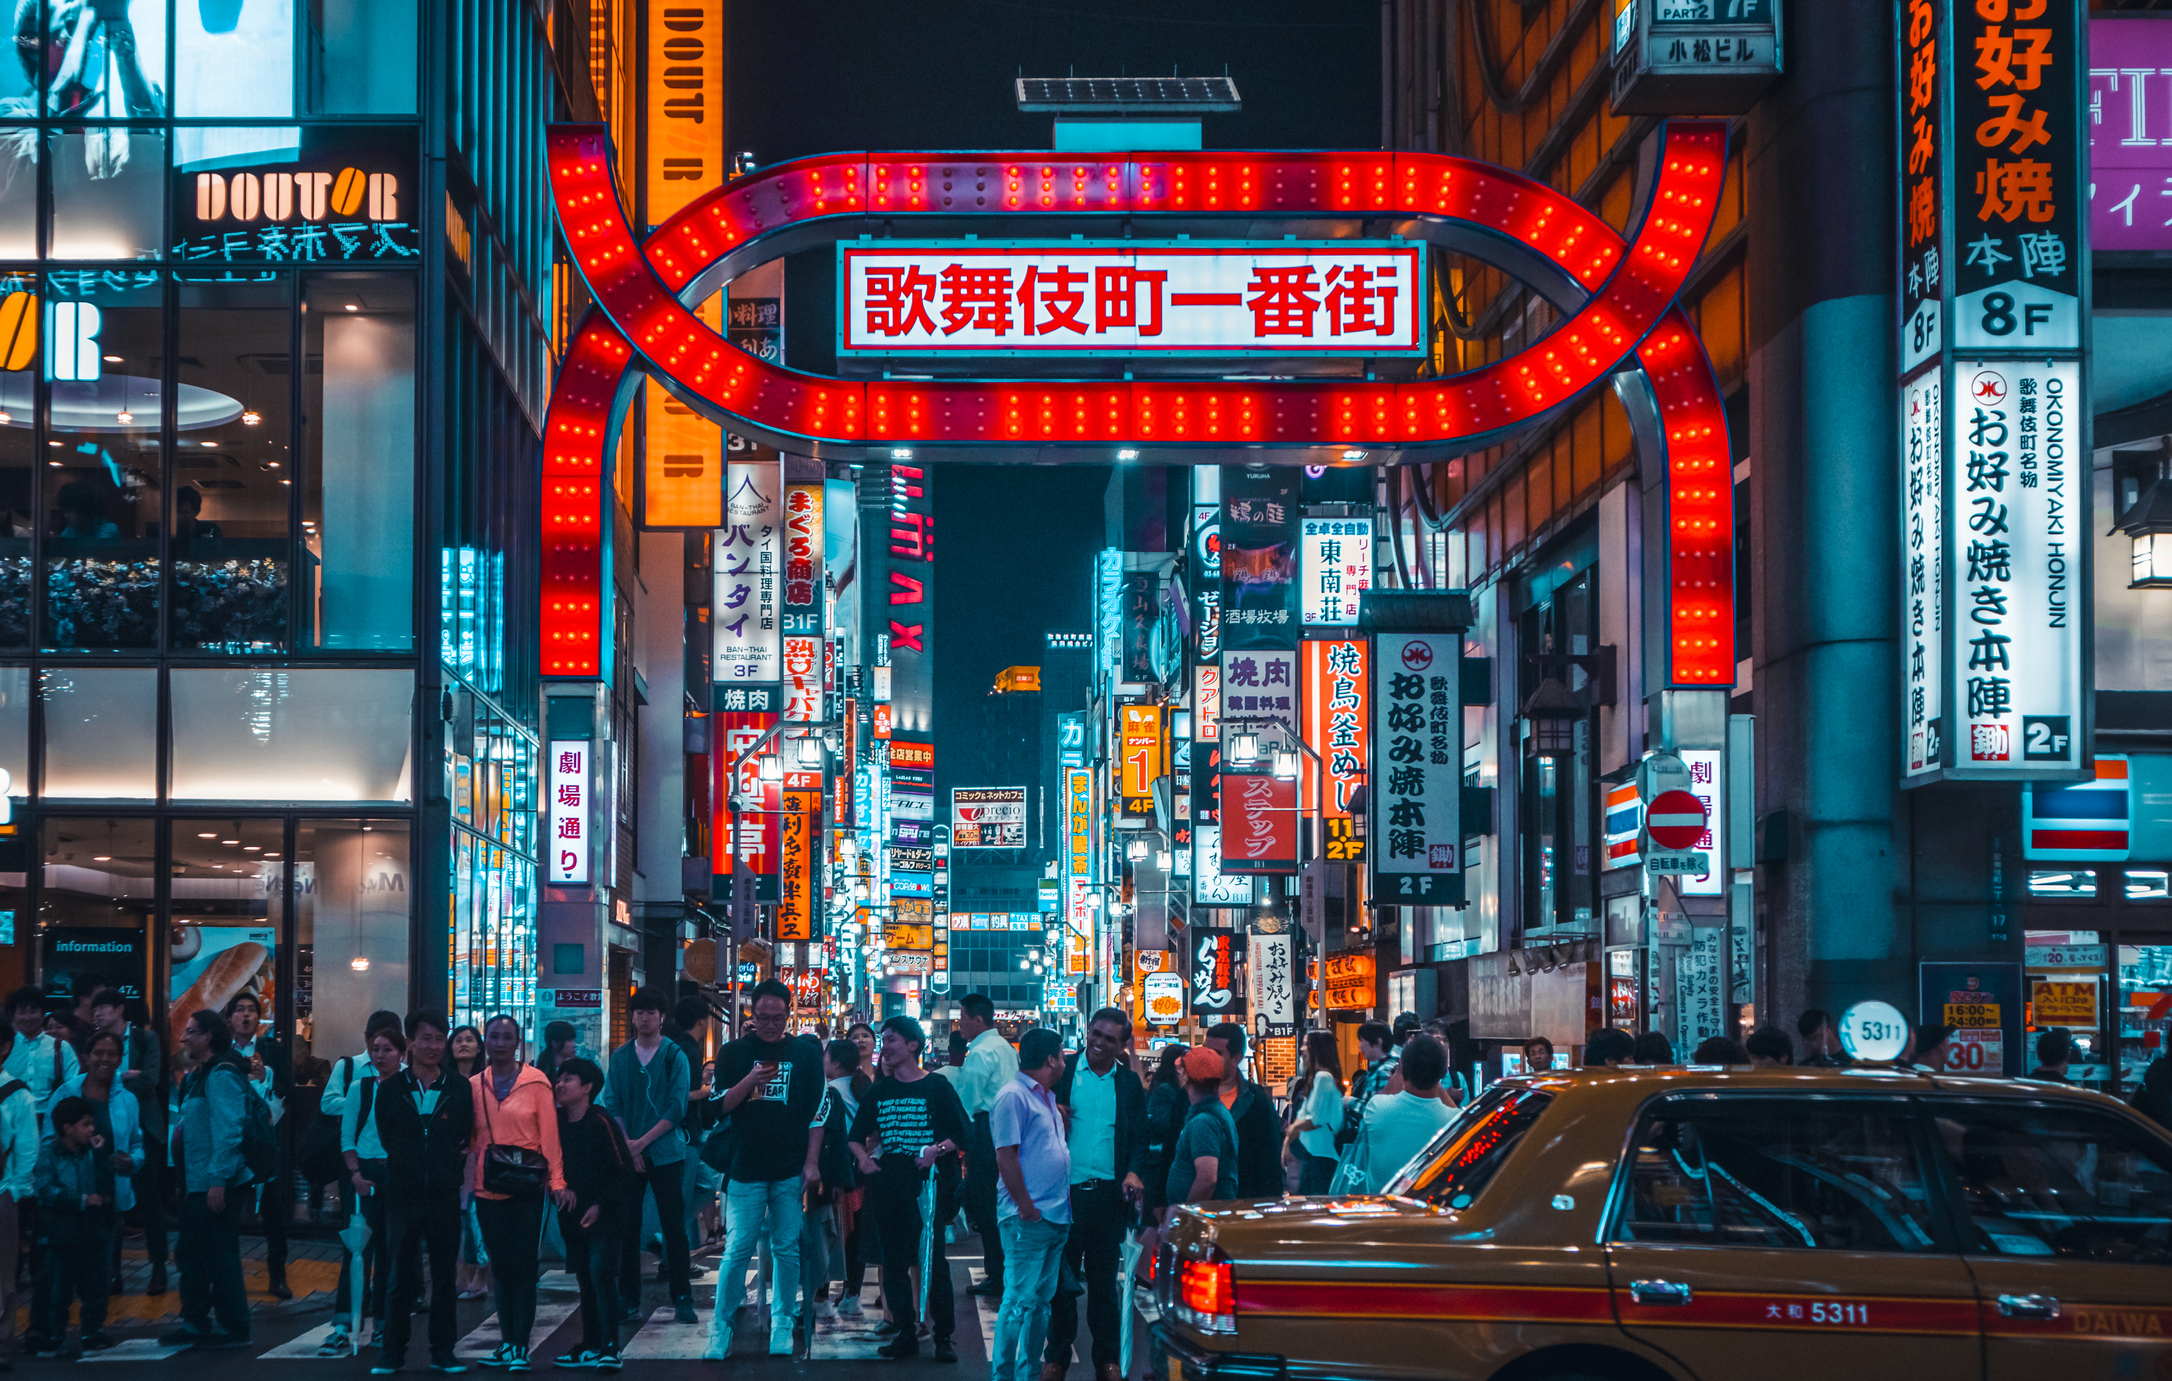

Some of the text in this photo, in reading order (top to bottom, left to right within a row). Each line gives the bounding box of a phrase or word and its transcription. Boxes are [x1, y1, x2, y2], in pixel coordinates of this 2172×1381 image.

[1664, 6, 1708, 19] PART2
[1669, 39, 1754, 62] 小松ビル
[663, 8, 704, 181] DOUTOR
[197, 167, 398, 220] DOUTOR
[1966, 230, 2067, 278] 本陣
[864, 263, 1399, 338] 歌舞伎町一番街
[1982, 291, 2053, 336] 8F
[1913, 311, 1936, 354] 8F
[2019, 378, 2039, 488] 歌舞伎町名物
[1198, 512, 1210, 520] 4F
[2046, 378, 2066, 629] OKONOMIYAKI HONJIN
[1305, 522, 1369, 536] 全卓全自動
[787, 490, 814, 606] まぐろ商店
[1966, 407, 2012, 719] お好み焼き本陣
[722, 524, 755, 638] バンタイ
[760, 525, 773, 630] タイ国料理専門店
[1320, 539, 1342, 622] 東南荘
[1358, 539, 1370, 600] リーチ麻
[1346, 565, 1356, 616] 専門店
[1305, 613, 1316, 622] 3F
[720, 653, 772, 661] RESTAURANT
[734, 665, 758, 677] 3F
[725, 689, 769, 711] 焼肉
[1201, 669, 1219, 739] クアトロ
[1127, 721, 1156, 733] 麻雀
[1327, 643, 1362, 813] 焼鳥釜めし
[1430, 676, 1448, 765] 歌舞伎町名物
[1128, 737, 1156, 745] ナンバー
[2027, 722, 2069, 754] 2F
[788, 774, 811, 787] 4F
[1127, 749, 1148, 792] 1
[558, 751, 581, 872] 劇場通り
[1129, 799, 1154, 813] 4F
[1243, 778, 1276, 857] ステップ
[1072, 775, 1088, 874] まんが喫茶
[1327, 841, 1364, 860] 2F
[1650, 858, 1704, 871] 自転車を除く
[1400, 876, 1433, 894] 2F
[1016, 914, 1028, 922] TAX
[1993, 915, 2006, 925] 17
[56, 940, 132, 953] information
[1266, 941, 1291, 1015] お好み焼き
[1687, 974, 1695, 997] Safety
[1695, 941, 1710, 1038] 防犯カメラ作動
[2034, 983, 2096, 996] ATM
[1273, 1026, 1293, 1036] B1F
[1862, 1021, 1900, 1040] 5311
[1946, 1042, 1983, 1070] 30
[1766, 1302, 1869, 1324] 大和 5311
[2072, 1311, 2164, 1335] DAIWA
